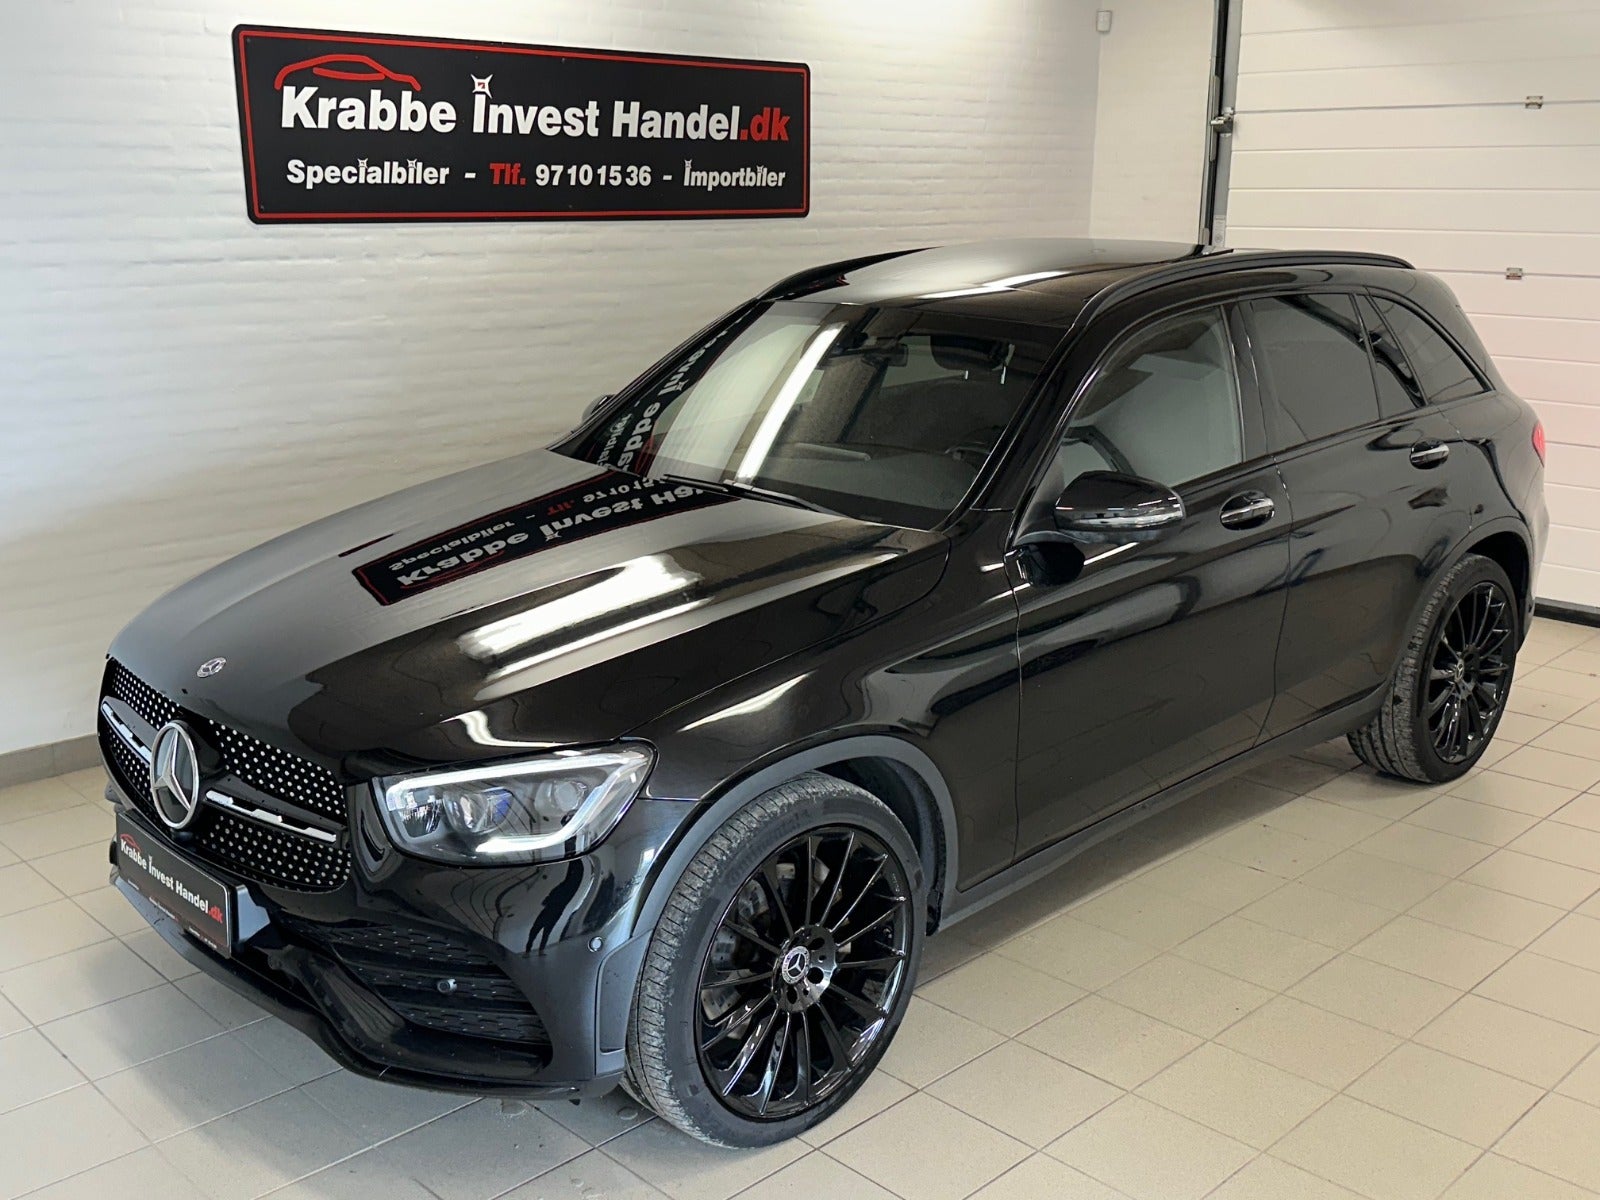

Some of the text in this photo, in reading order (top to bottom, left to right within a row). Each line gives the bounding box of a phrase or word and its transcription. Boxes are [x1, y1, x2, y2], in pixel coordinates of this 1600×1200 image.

[281, 74, 790, 141] Krabbe Invest Handel.dk
[286, 158, 450, 189] Specialbiler
[489, 163, 527, 185] Tlf.
[683, 159, 786, 191] Importbiler
[120, 839, 147, 870] Krabbe
[148, 854, 174, 891] Invest
